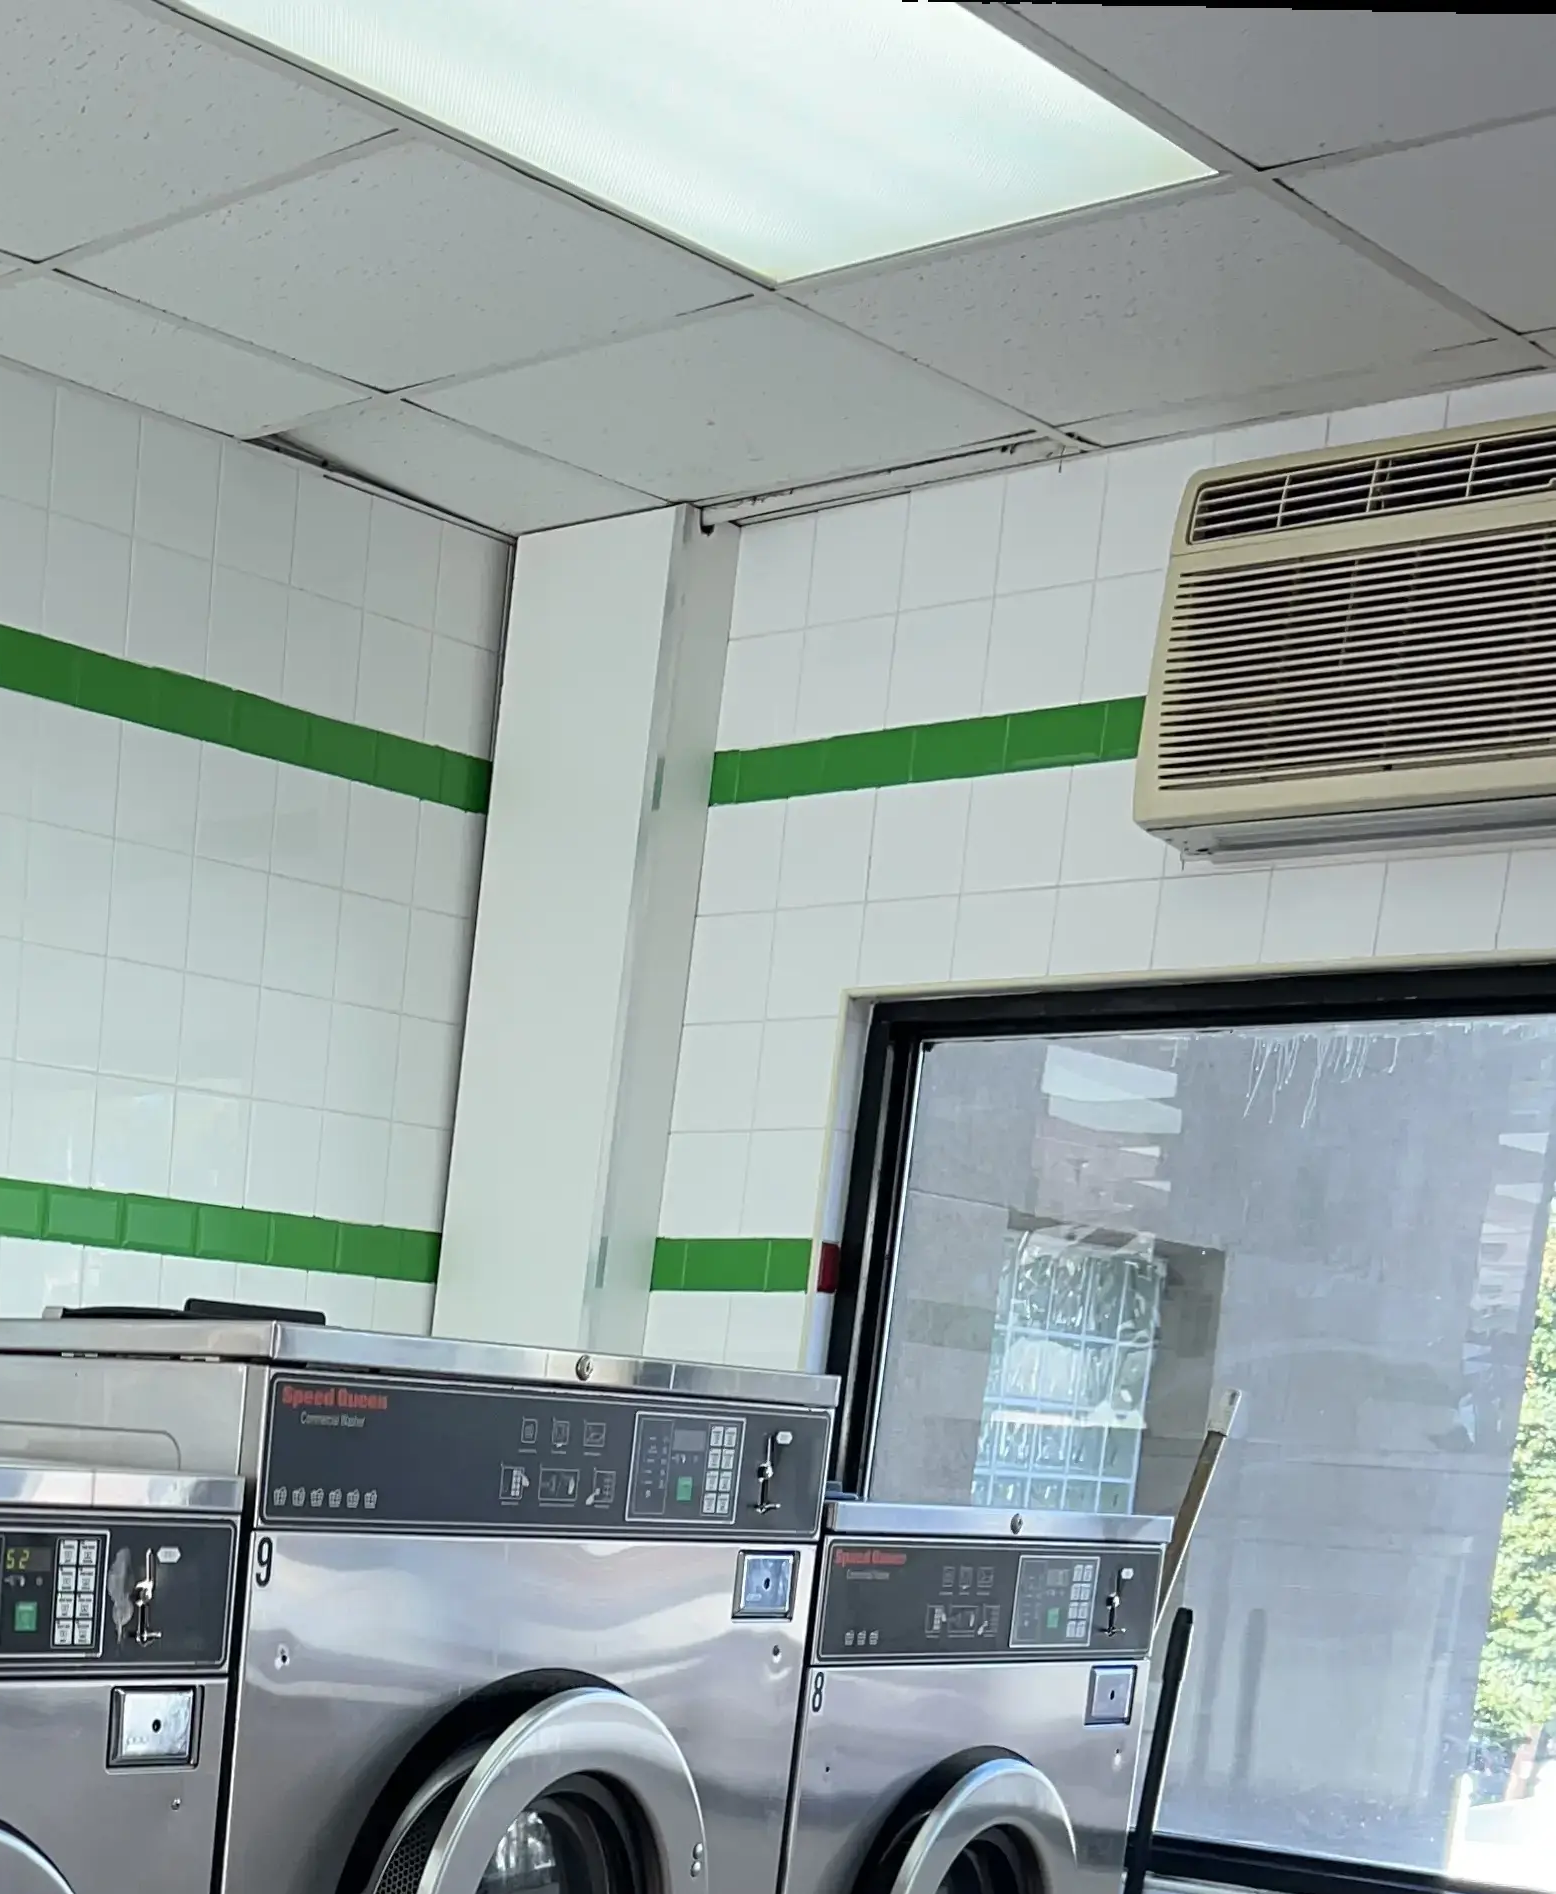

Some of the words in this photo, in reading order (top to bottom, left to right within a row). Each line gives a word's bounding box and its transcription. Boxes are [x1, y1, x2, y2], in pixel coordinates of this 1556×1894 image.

[282, 1386, 335, 1408] Speed
[337, 1388, 388, 1410] Queen
[6, 1548, 29, 1570] 52
[256, 1537, 273, 1587] 9
[812, 1672, 824, 1713] 8
